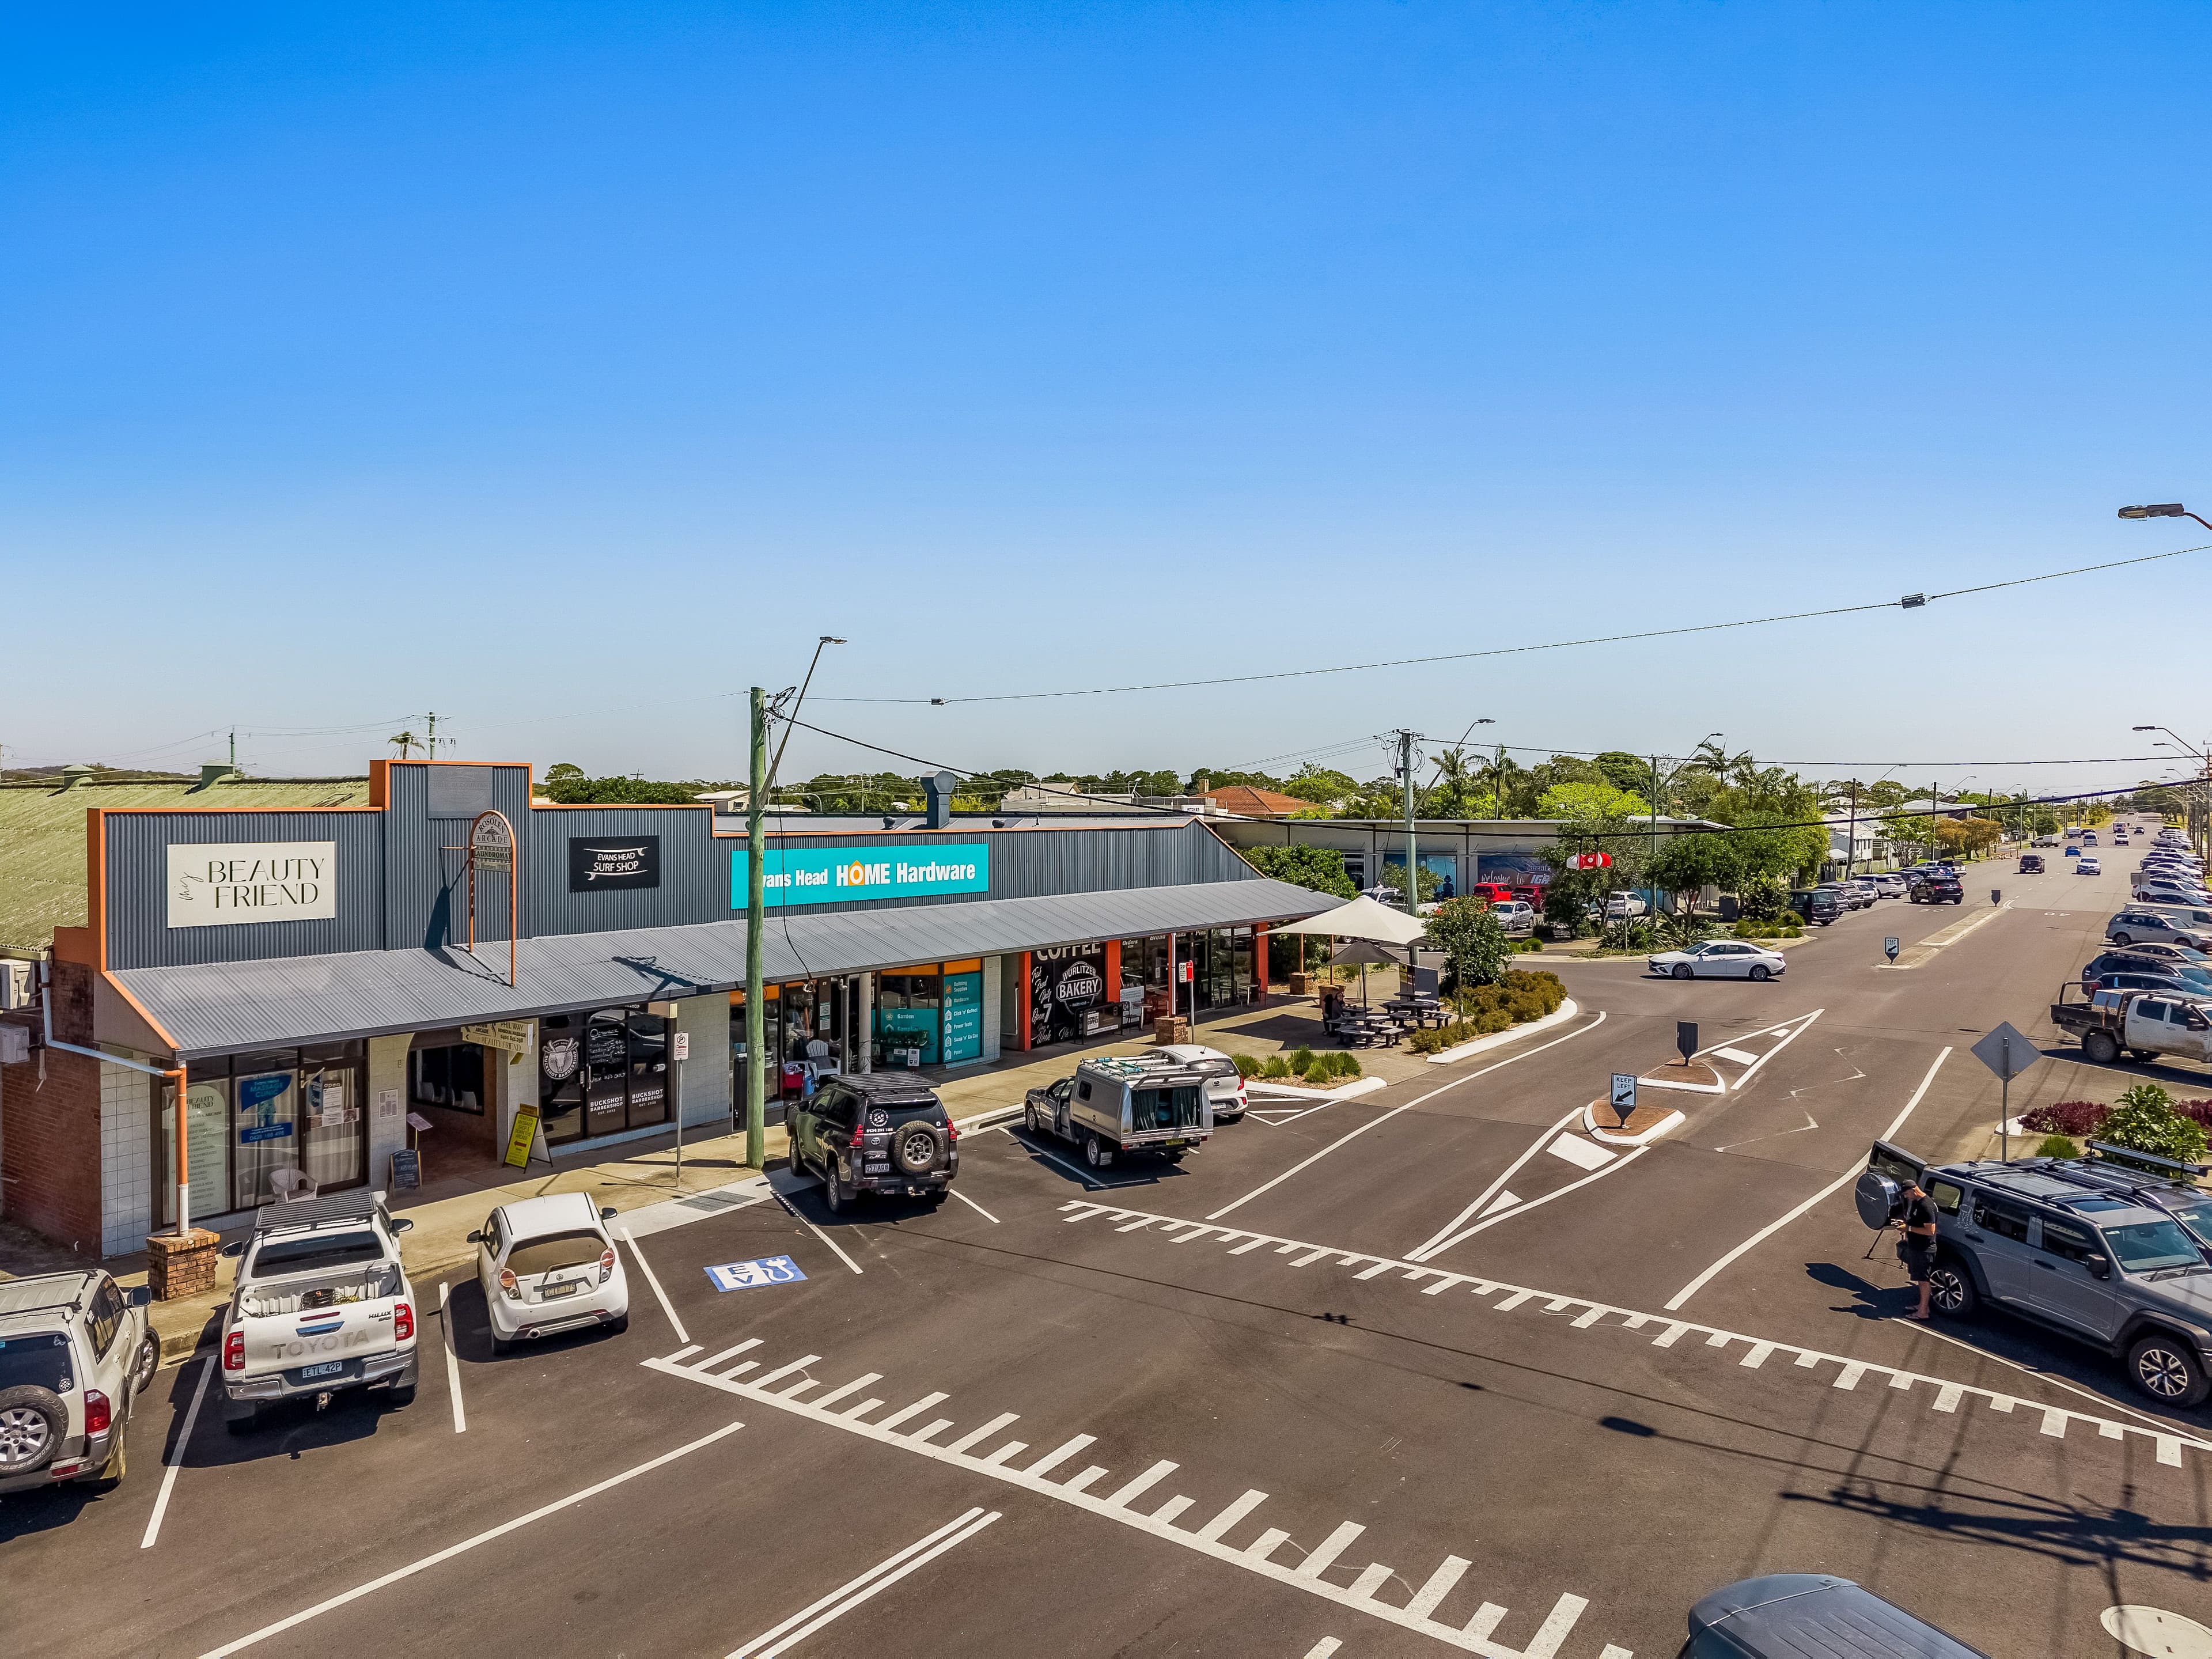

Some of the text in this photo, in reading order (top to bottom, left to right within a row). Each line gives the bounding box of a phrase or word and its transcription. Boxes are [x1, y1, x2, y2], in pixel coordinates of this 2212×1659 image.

[479, 817, 506, 834] ROSOLEN
[476, 835, 507, 844] ARCADE
[474, 850, 511, 859] LAUNDROMAT
[618, 852, 635, 861] HEAD
[209, 858, 324, 883] BEAUTY
[593, 861, 639, 872] SURF SHOP
[763, 861, 975, 888] vans Head HOME Hardware
[1482, 870, 1512, 885] welcome
[1517, 872, 1525, 885] to
[215, 883, 318, 908] FRIEND
[1062, 965, 1096, 981] WURLITZER
[1059, 979, 1099, 999] BAKERY
[1032, 1003, 1052, 1025] Open 7
[481, 1036, 501, 1047] BEAUTY
[502, 1041, 521, 1051] FRIEND
[544, 1055, 558, 1078] BUCKSHOT
[558, 1051, 577, 1078] BARBERSHOP
[250, 1082, 283, 1092] MASSAGE
[255, 1089, 278, 1097] CLINIC
[632, 1089, 664, 1099] BUCKSHOT
[187, 1096, 214, 1104] BEAUTY
[590, 1096, 623, 1107] BUCKSHOT
[632, 1094, 664, 1104] BARBERSHOP
[187, 1101, 214, 1110] FRIEND
[590, 1102, 623, 1112] BARBERSHOP
[368, 1310, 392, 1319] HILUX
[271, 1329, 370, 1359] TOYOTA
